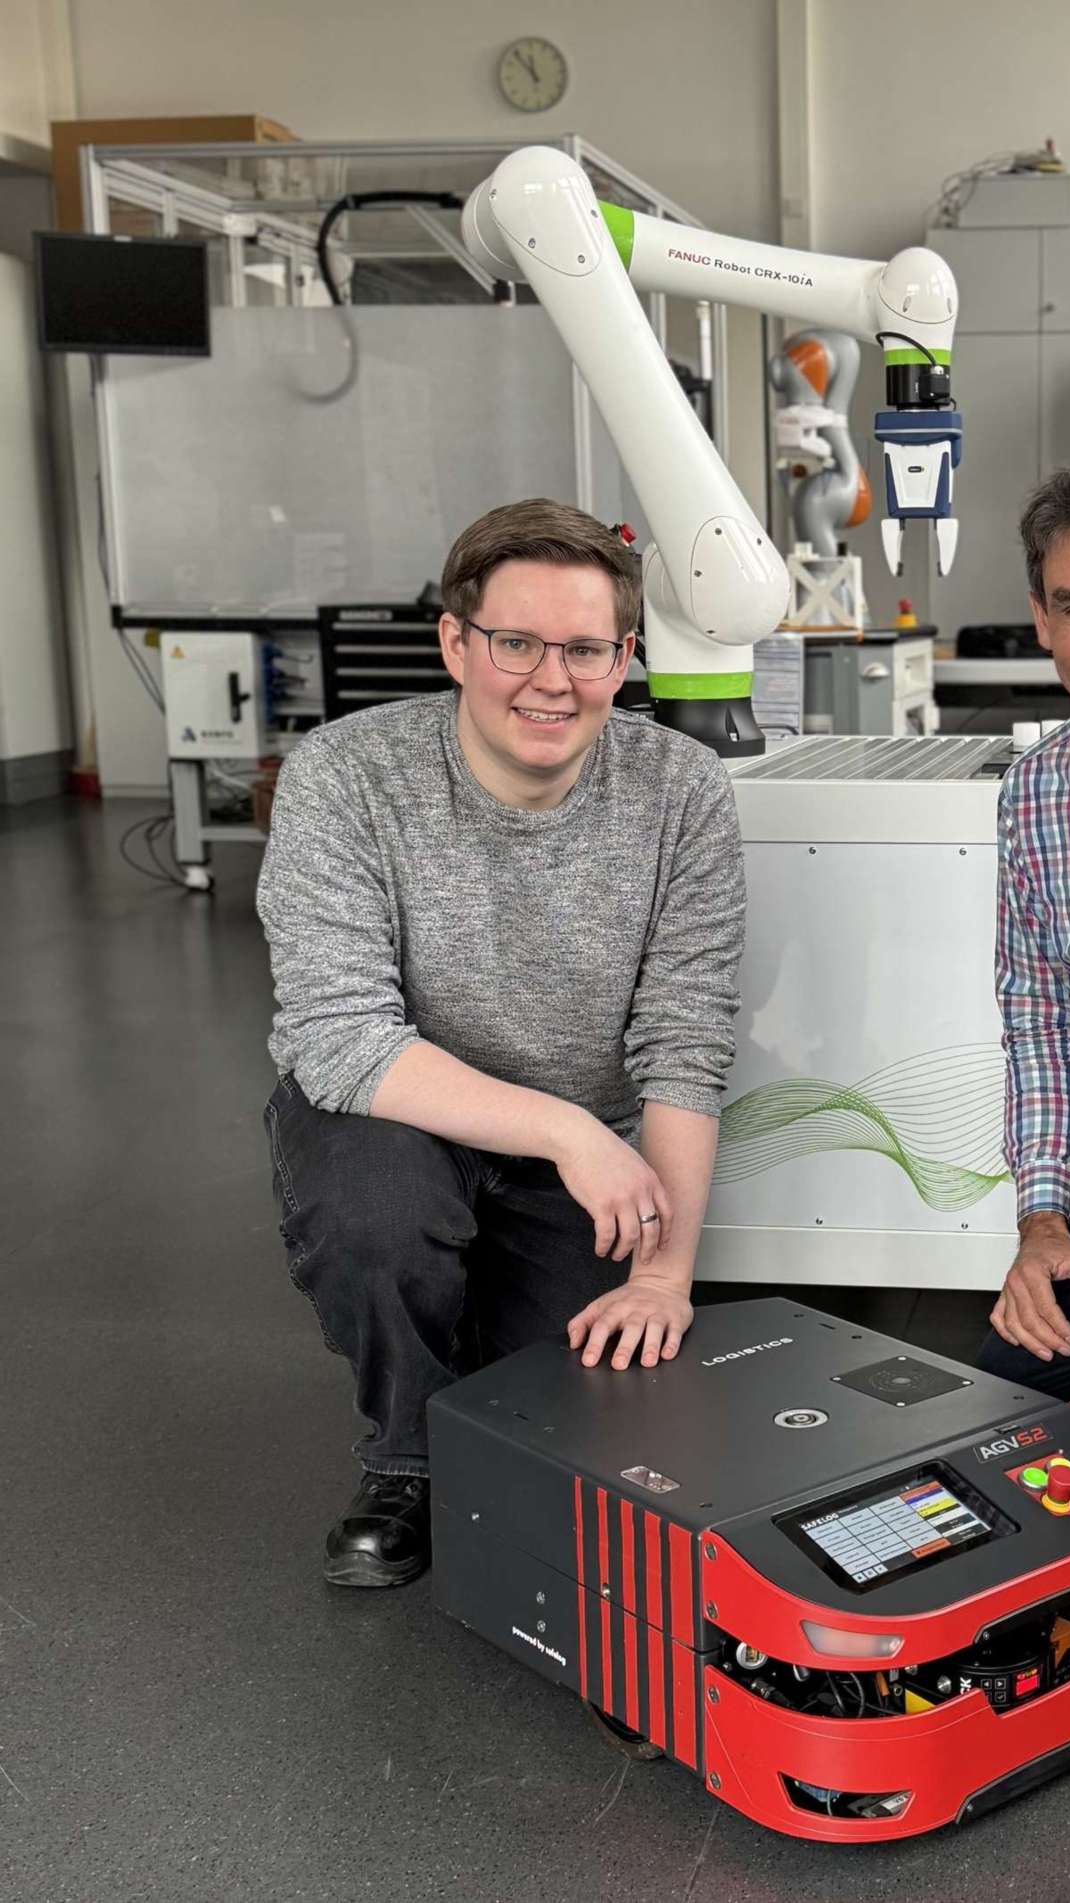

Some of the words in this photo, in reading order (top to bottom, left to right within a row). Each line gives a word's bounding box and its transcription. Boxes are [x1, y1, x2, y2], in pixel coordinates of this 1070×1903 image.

[668, 249, 711, 266] FANUC
[714, 259, 751, 274] Robot
[701, 1337, 793, 1366] LOGISTICS
[800, 1512, 840, 1531] SAFELOG
